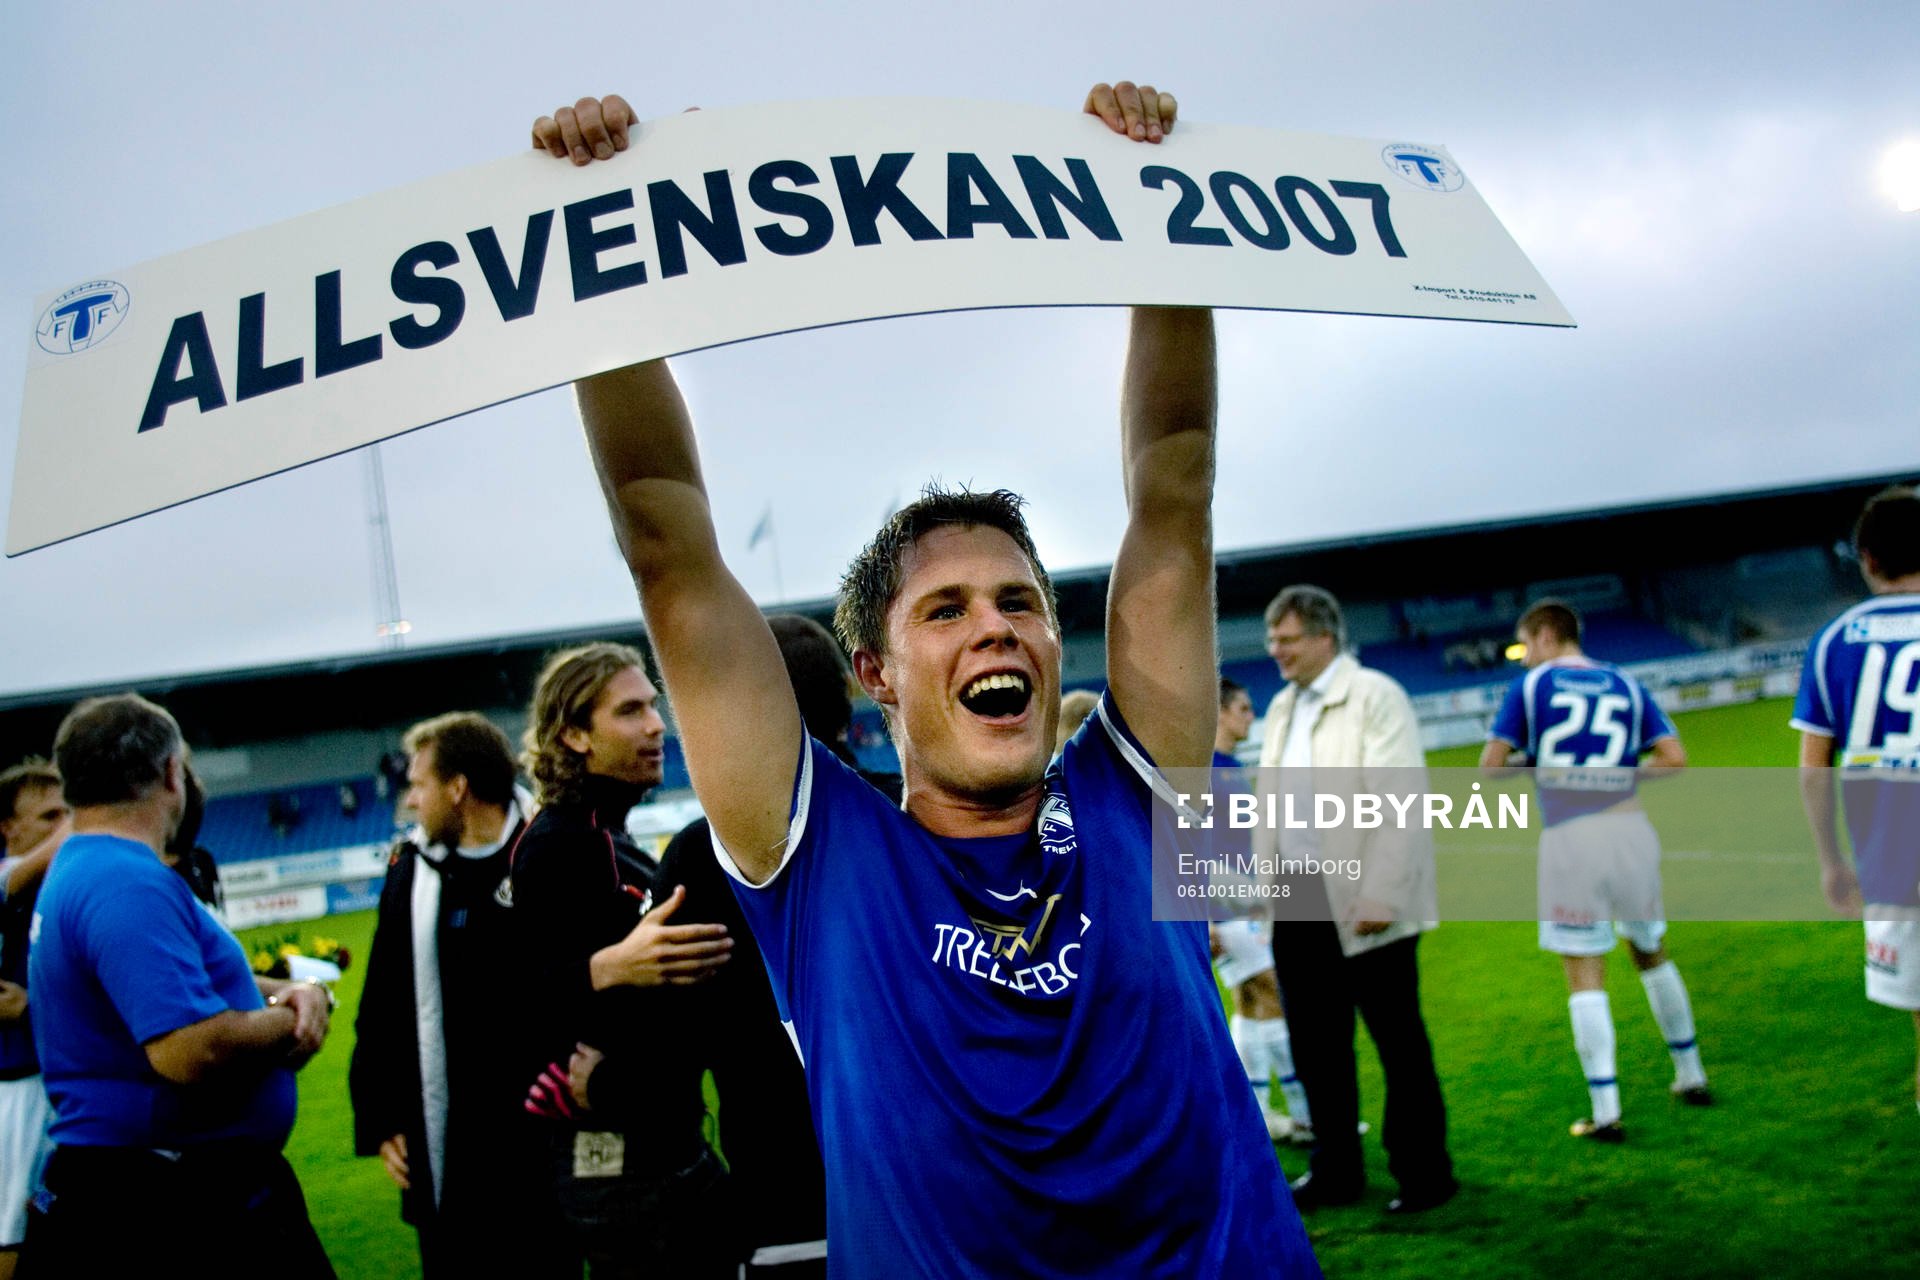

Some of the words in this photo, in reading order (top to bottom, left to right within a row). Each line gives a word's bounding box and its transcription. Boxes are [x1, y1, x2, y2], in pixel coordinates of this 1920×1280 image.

[137, 152, 1123, 434] ALLSVENSKAN
[1140, 165, 1408, 258] 2007
[1538, 692, 1631, 769] 25
[1847, 641, 1920, 752] 19
